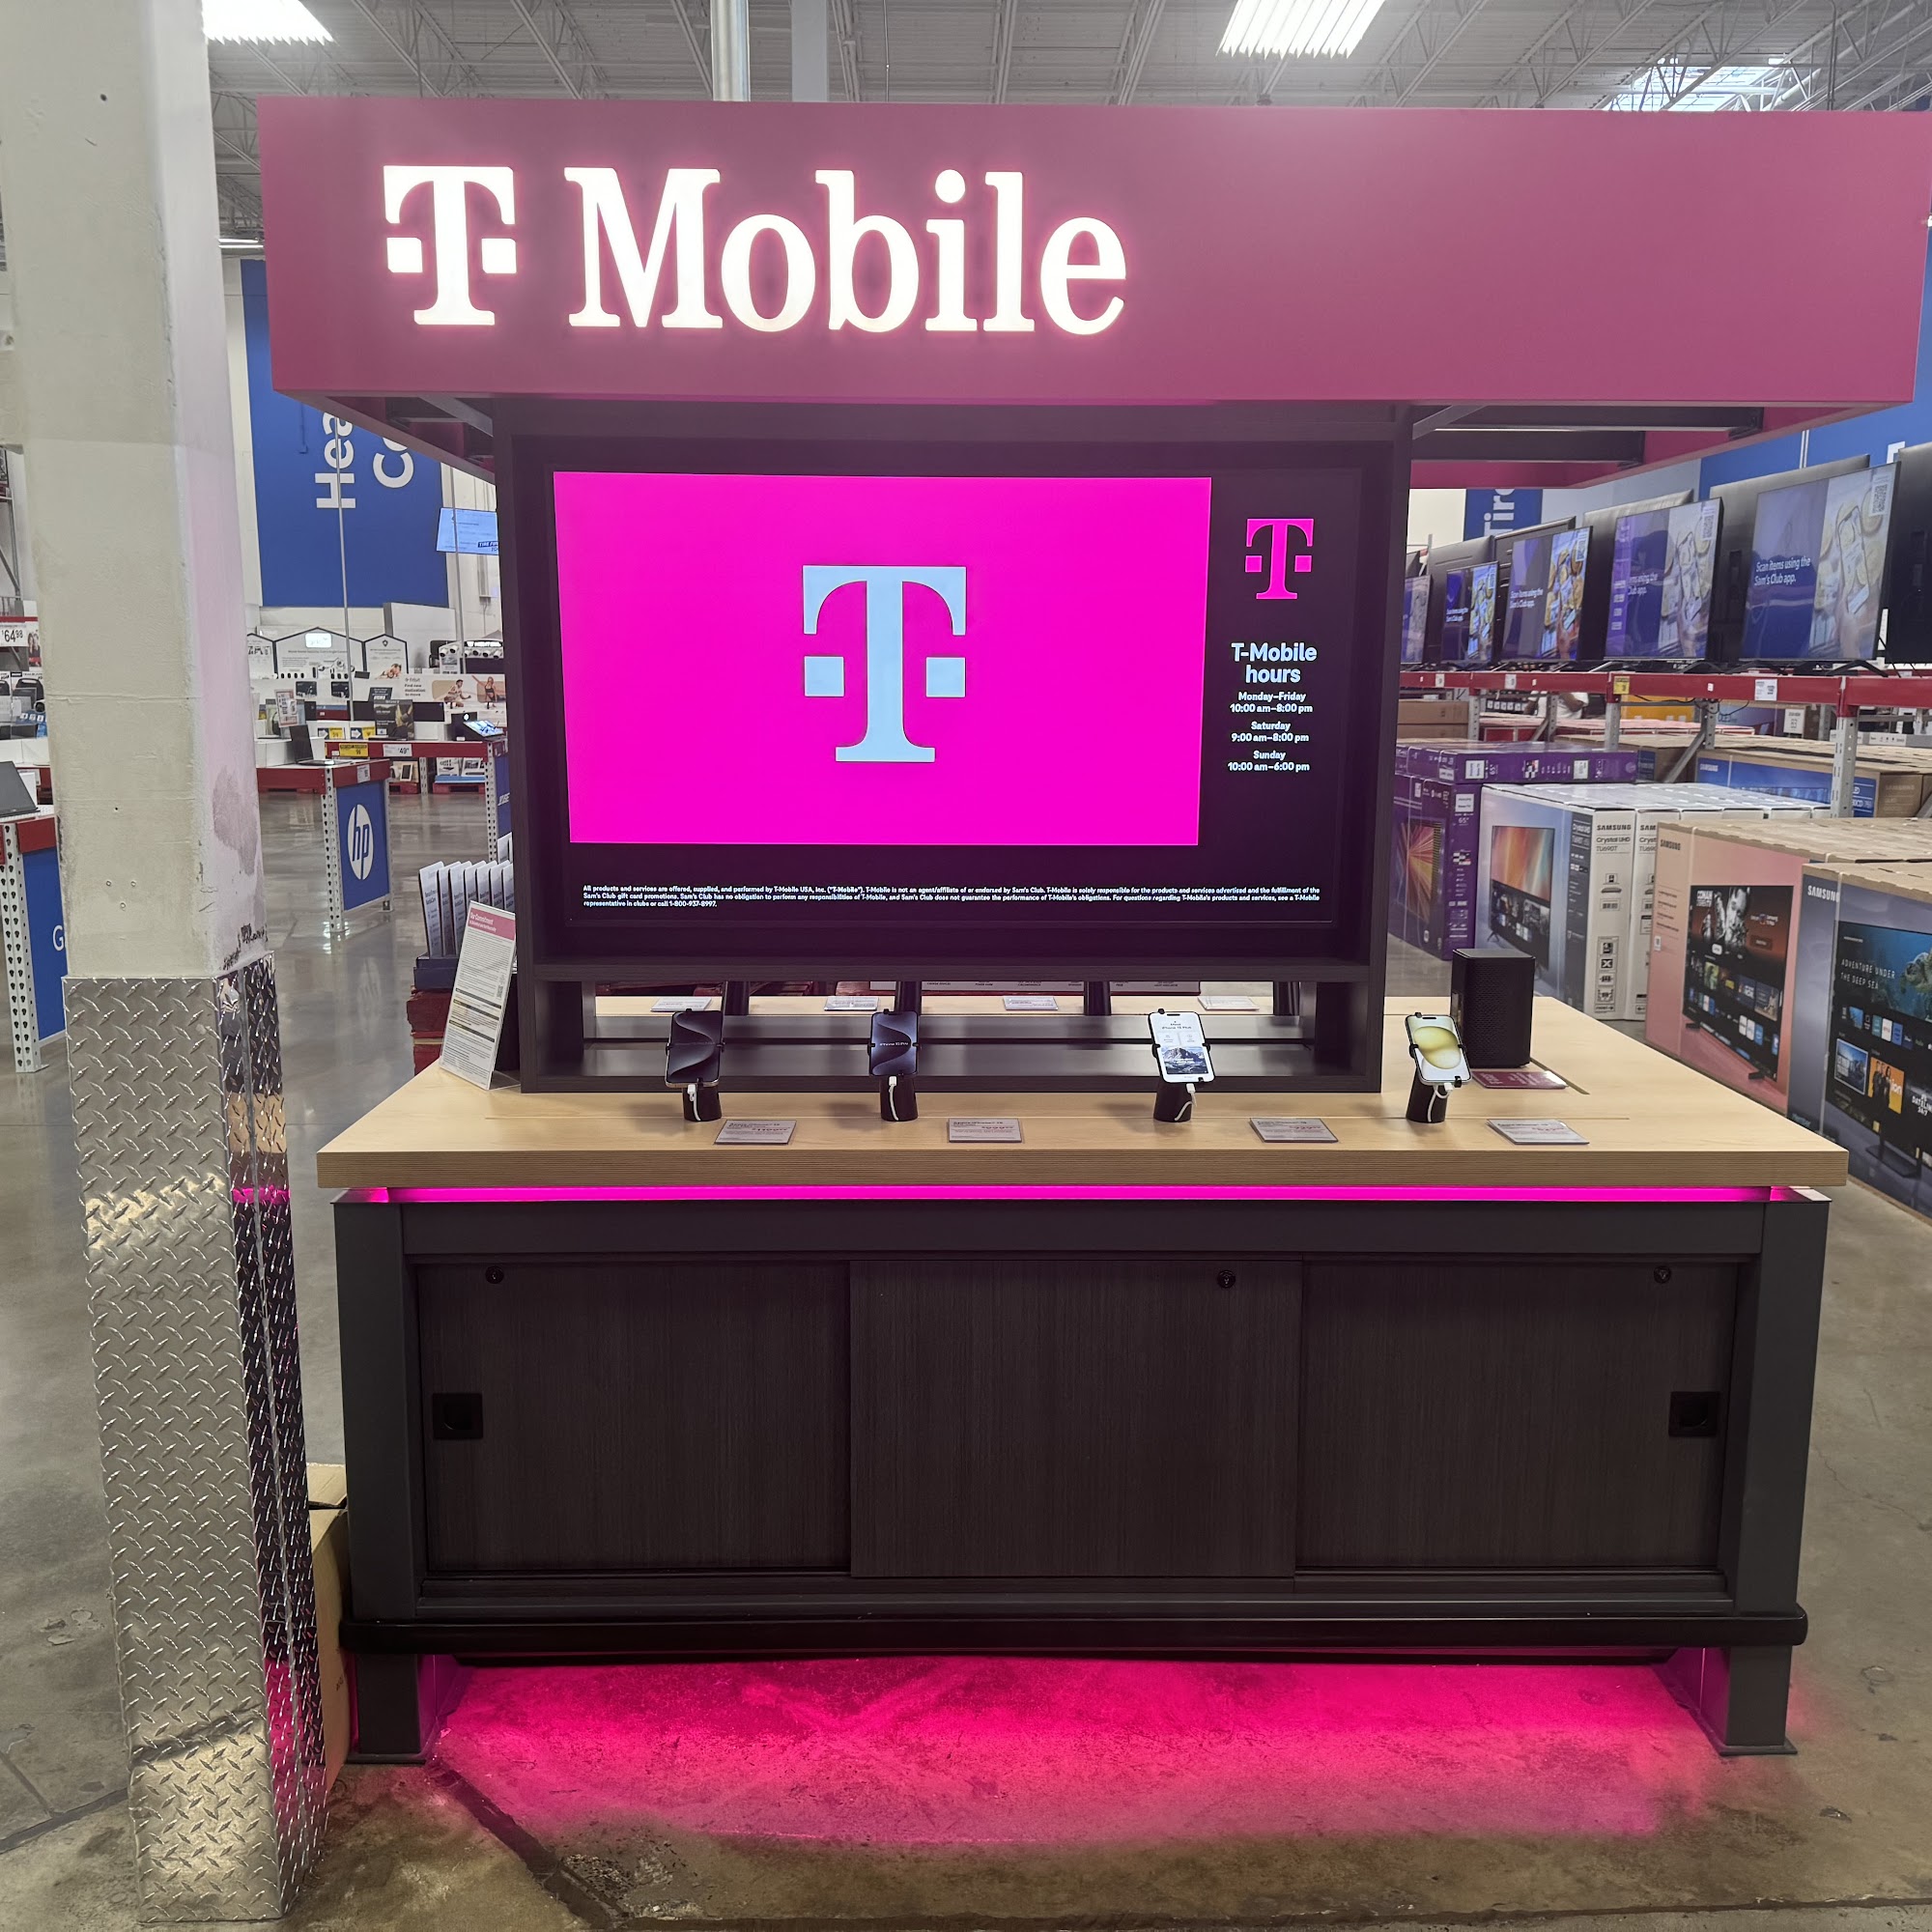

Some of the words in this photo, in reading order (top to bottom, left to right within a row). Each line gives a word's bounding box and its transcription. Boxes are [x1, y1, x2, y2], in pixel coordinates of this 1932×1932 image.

[563, 167, 1126, 335] Mobile
[1245, 519, 1314, 599] T
[1756, 561, 1769, 572] Scan
[1769, 559, 1784, 570] items
[1785, 557, 1801, 570] using
[1801, 555, 1810, 567] the
[1754, 575, 1770, 585] Sam's
[1771, 573, 1782, 584] Club
[1231, 642, 1318, 662] T-Mobile
[803, 565, 967, 762] T
[1245, 665, 1301, 684] hours
[1230, 703, 1256, 713] 10:00
[1298, 705, 1313, 714] pm
[1251, 721, 1291, 731] Saturday
[1231, 732, 1252, 742] 9:00
[1294, 735, 1309, 744] pm
[1253, 751, 1286, 760] Sunday
[1228, 762, 1254, 771] 10:00
[350, 804, 372, 880] hp
[1660, 839, 1681, 851] SAMSUNG
[1807, 885, 1839, 903] SAMSUNG
[1841, 958, 1873, 974] ADVENTURE
[1874, 968, 1895, 979] UNDER
[1840, 972, 1850, 982] THE
[1852, 975, 1865, 985] DEEP
[1867, 980, 1879, 989] SEA
